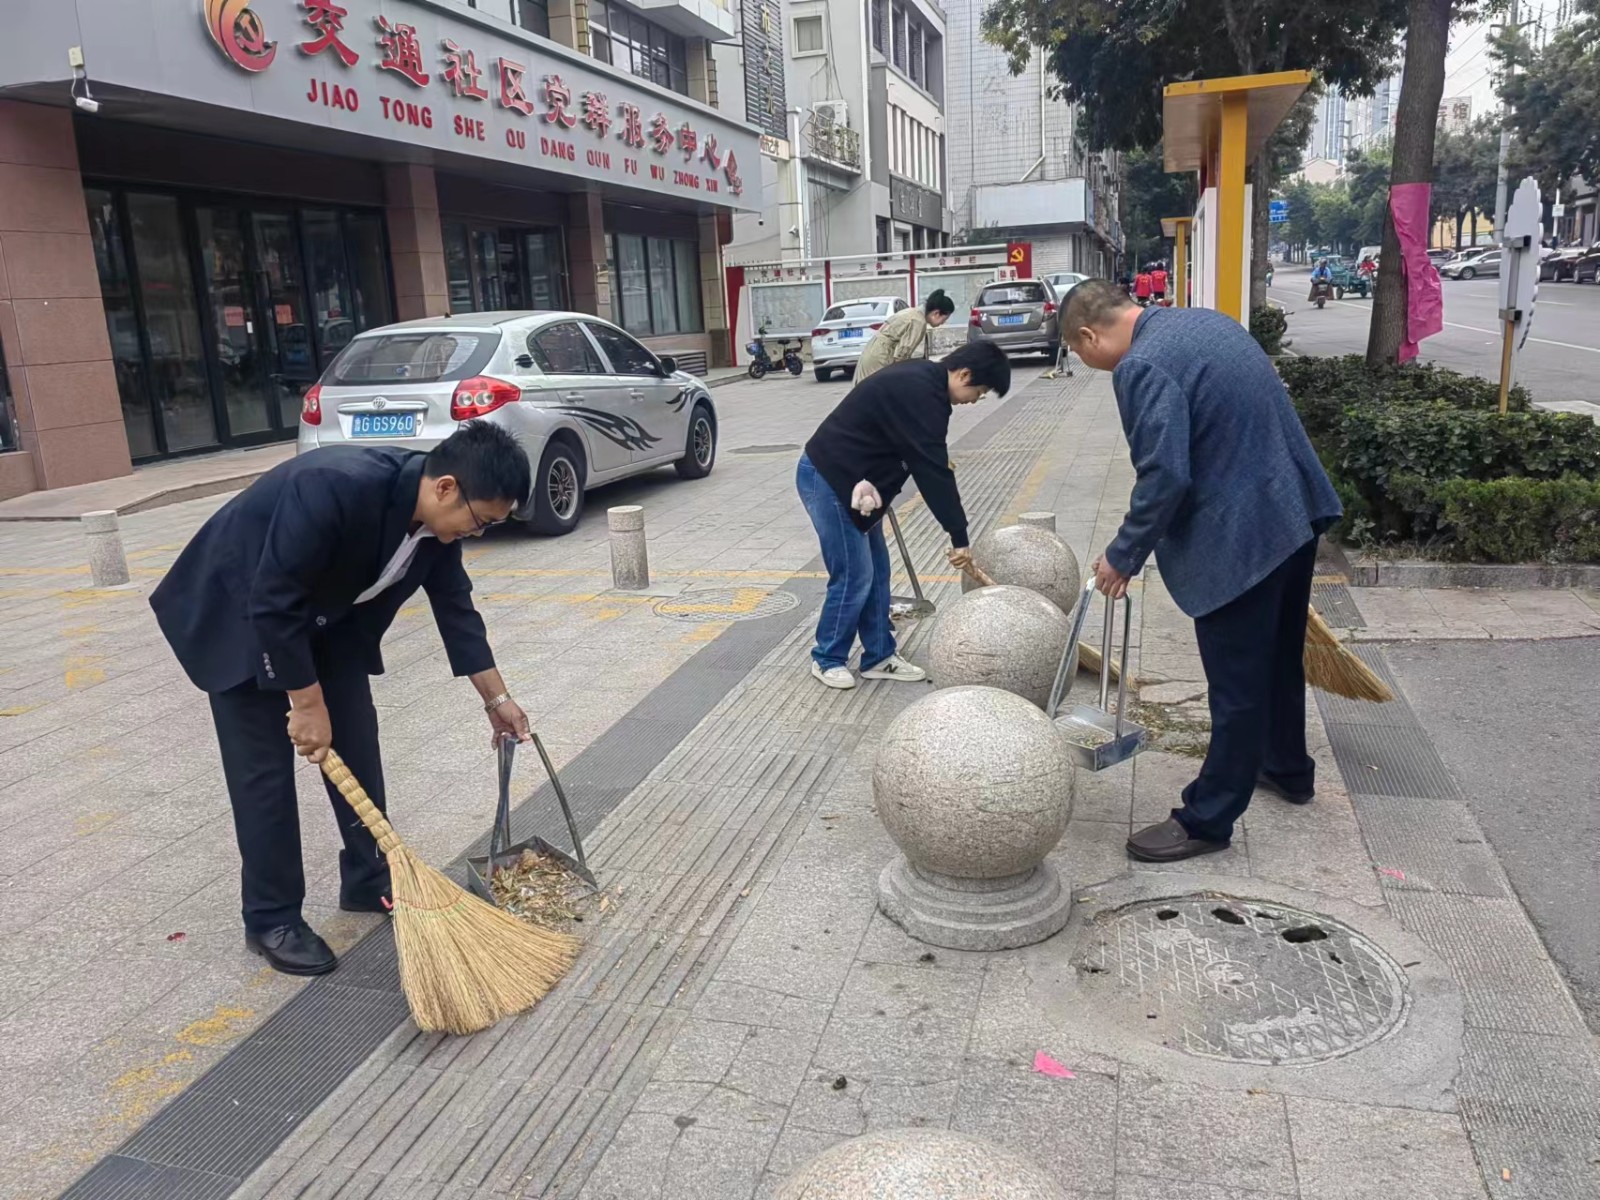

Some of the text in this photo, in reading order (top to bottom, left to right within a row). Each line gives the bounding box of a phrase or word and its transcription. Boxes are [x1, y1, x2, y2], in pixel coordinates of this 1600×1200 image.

[299, 0, 721, 170] 交通社区党群服务中心
[307, 79, 719, 192] JIAO TONG SHE QU DANG QUN FU WU ZHONG XIN
